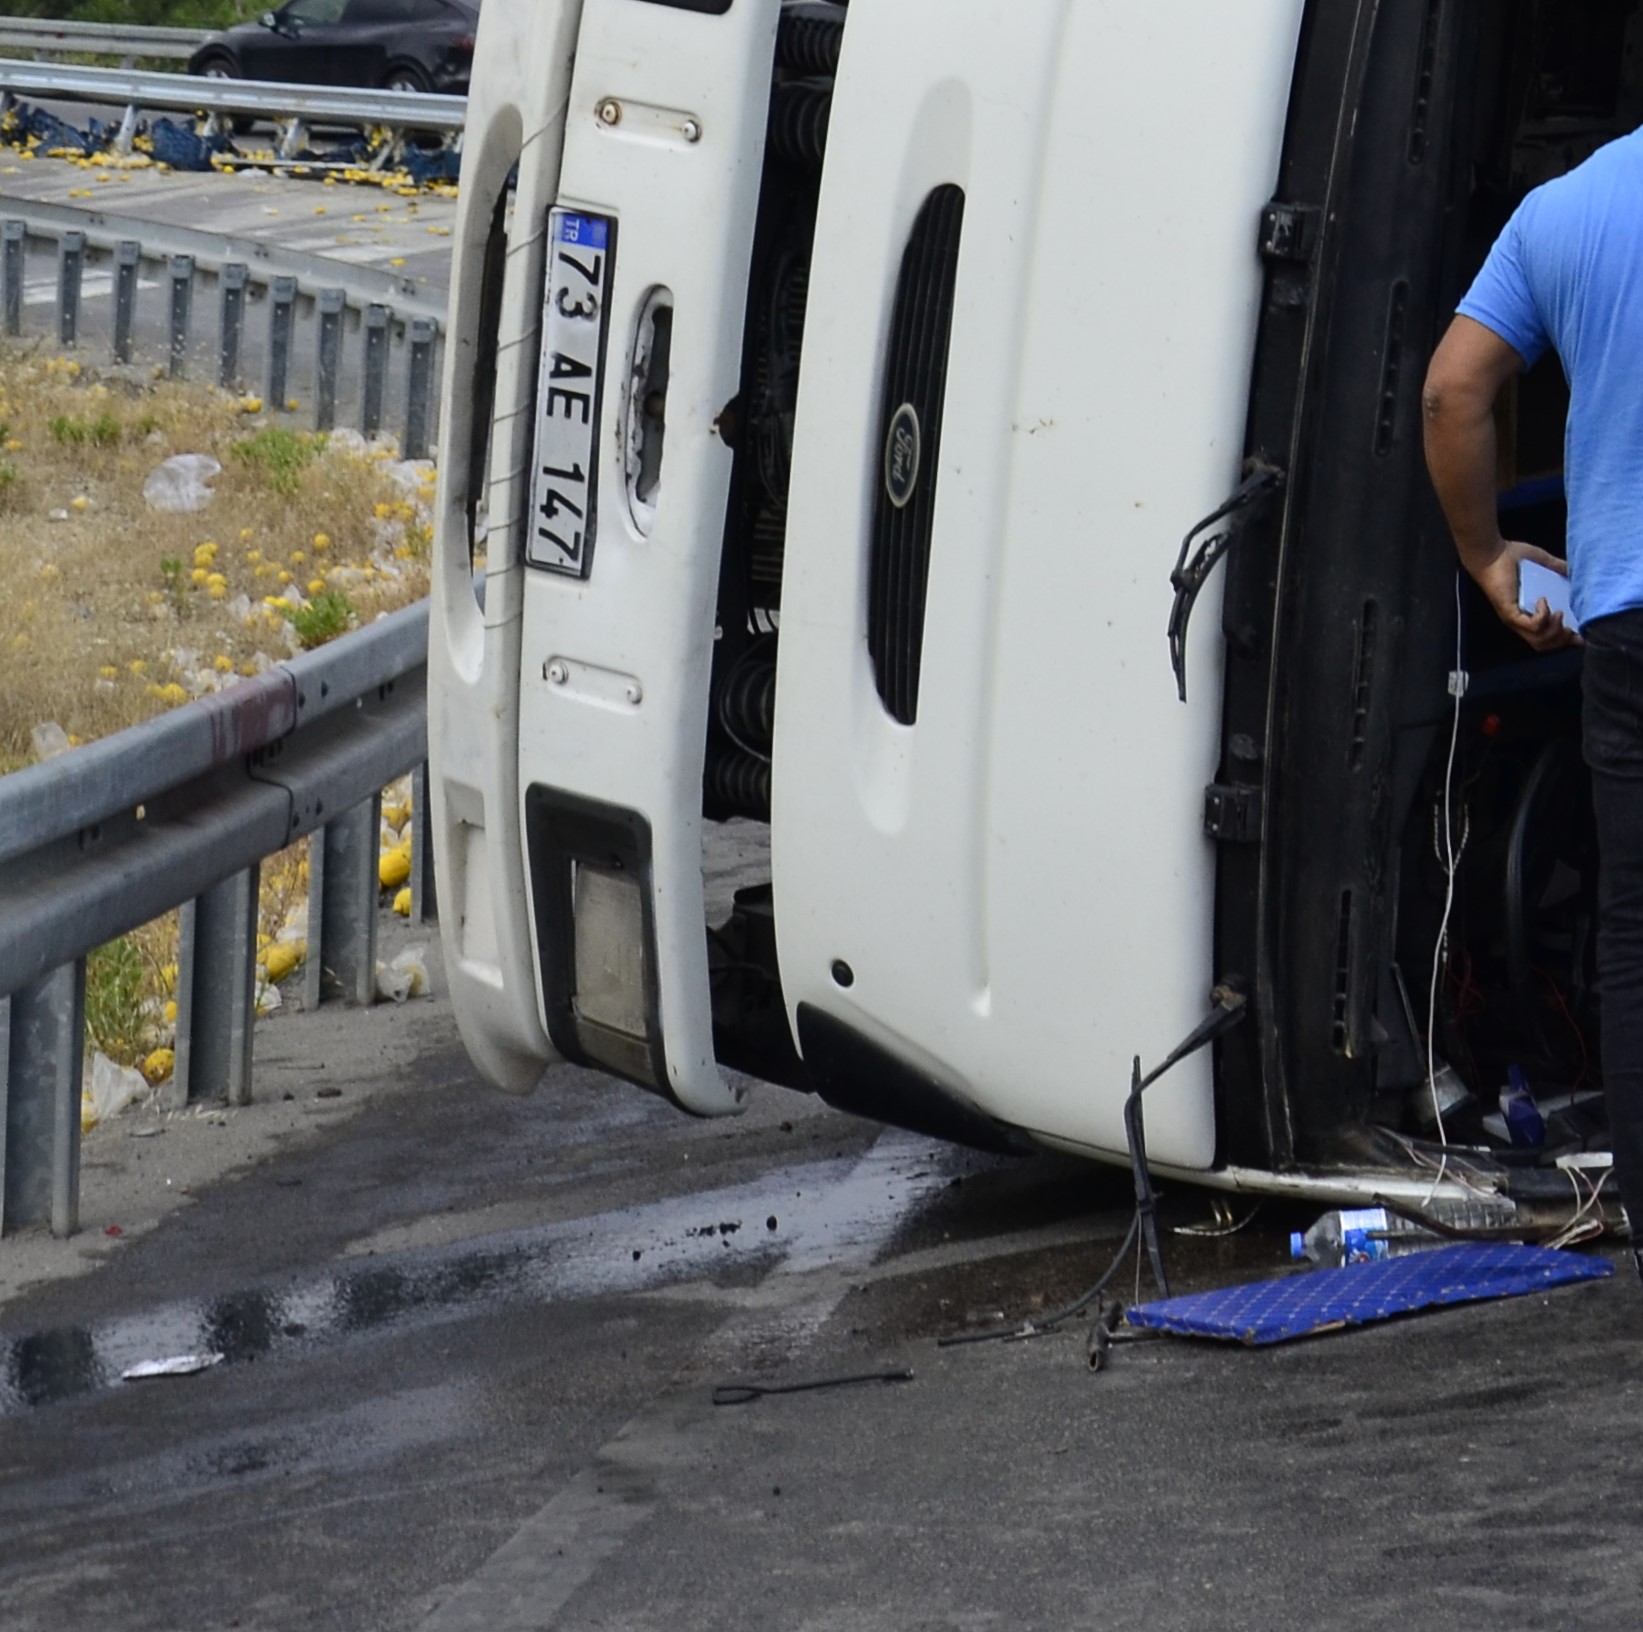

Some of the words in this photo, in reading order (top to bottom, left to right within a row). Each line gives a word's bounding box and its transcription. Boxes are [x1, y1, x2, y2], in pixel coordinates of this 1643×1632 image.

[564, 218, 580, 242] TR
[555, 251, 602, 322] 73
[547, 352, 593, 424] AE
[892, 426, 913, 484] Ford
[538, 463, 585, 562] 147
